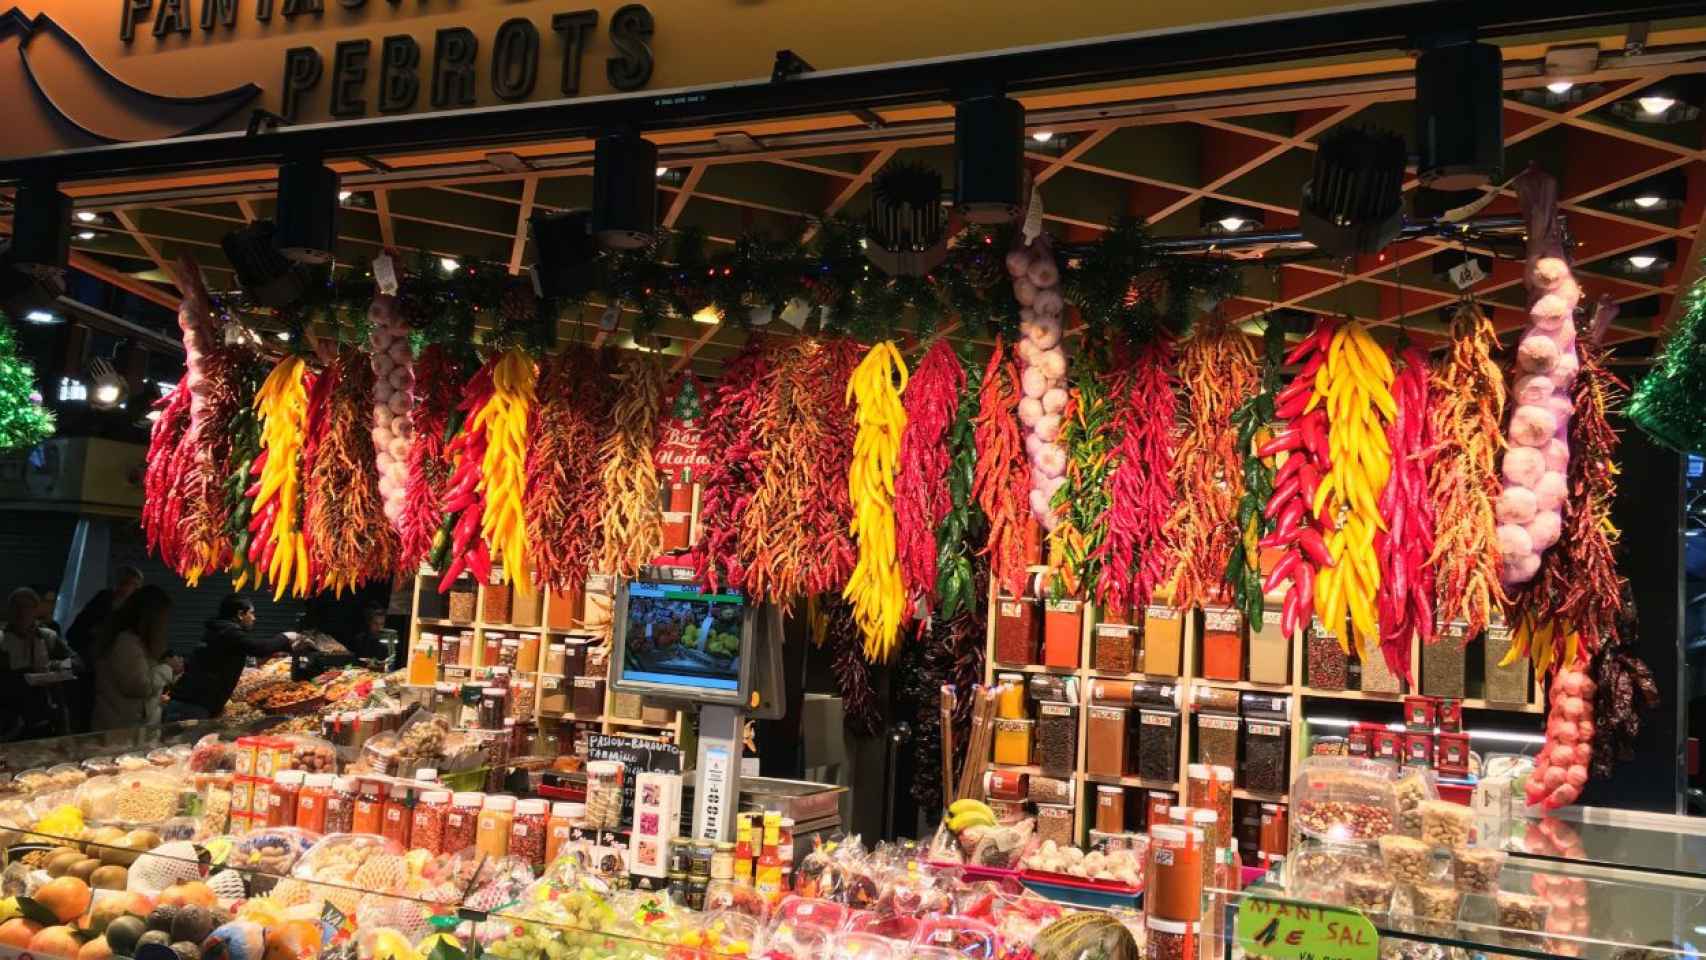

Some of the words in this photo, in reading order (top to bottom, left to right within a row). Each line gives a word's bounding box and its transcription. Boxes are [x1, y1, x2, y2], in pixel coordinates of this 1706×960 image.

[282, 4, 654, 121] PEBROTS
[655, 449, 711, 465] Nada
[1325, 922, 1371, 946] SAL
